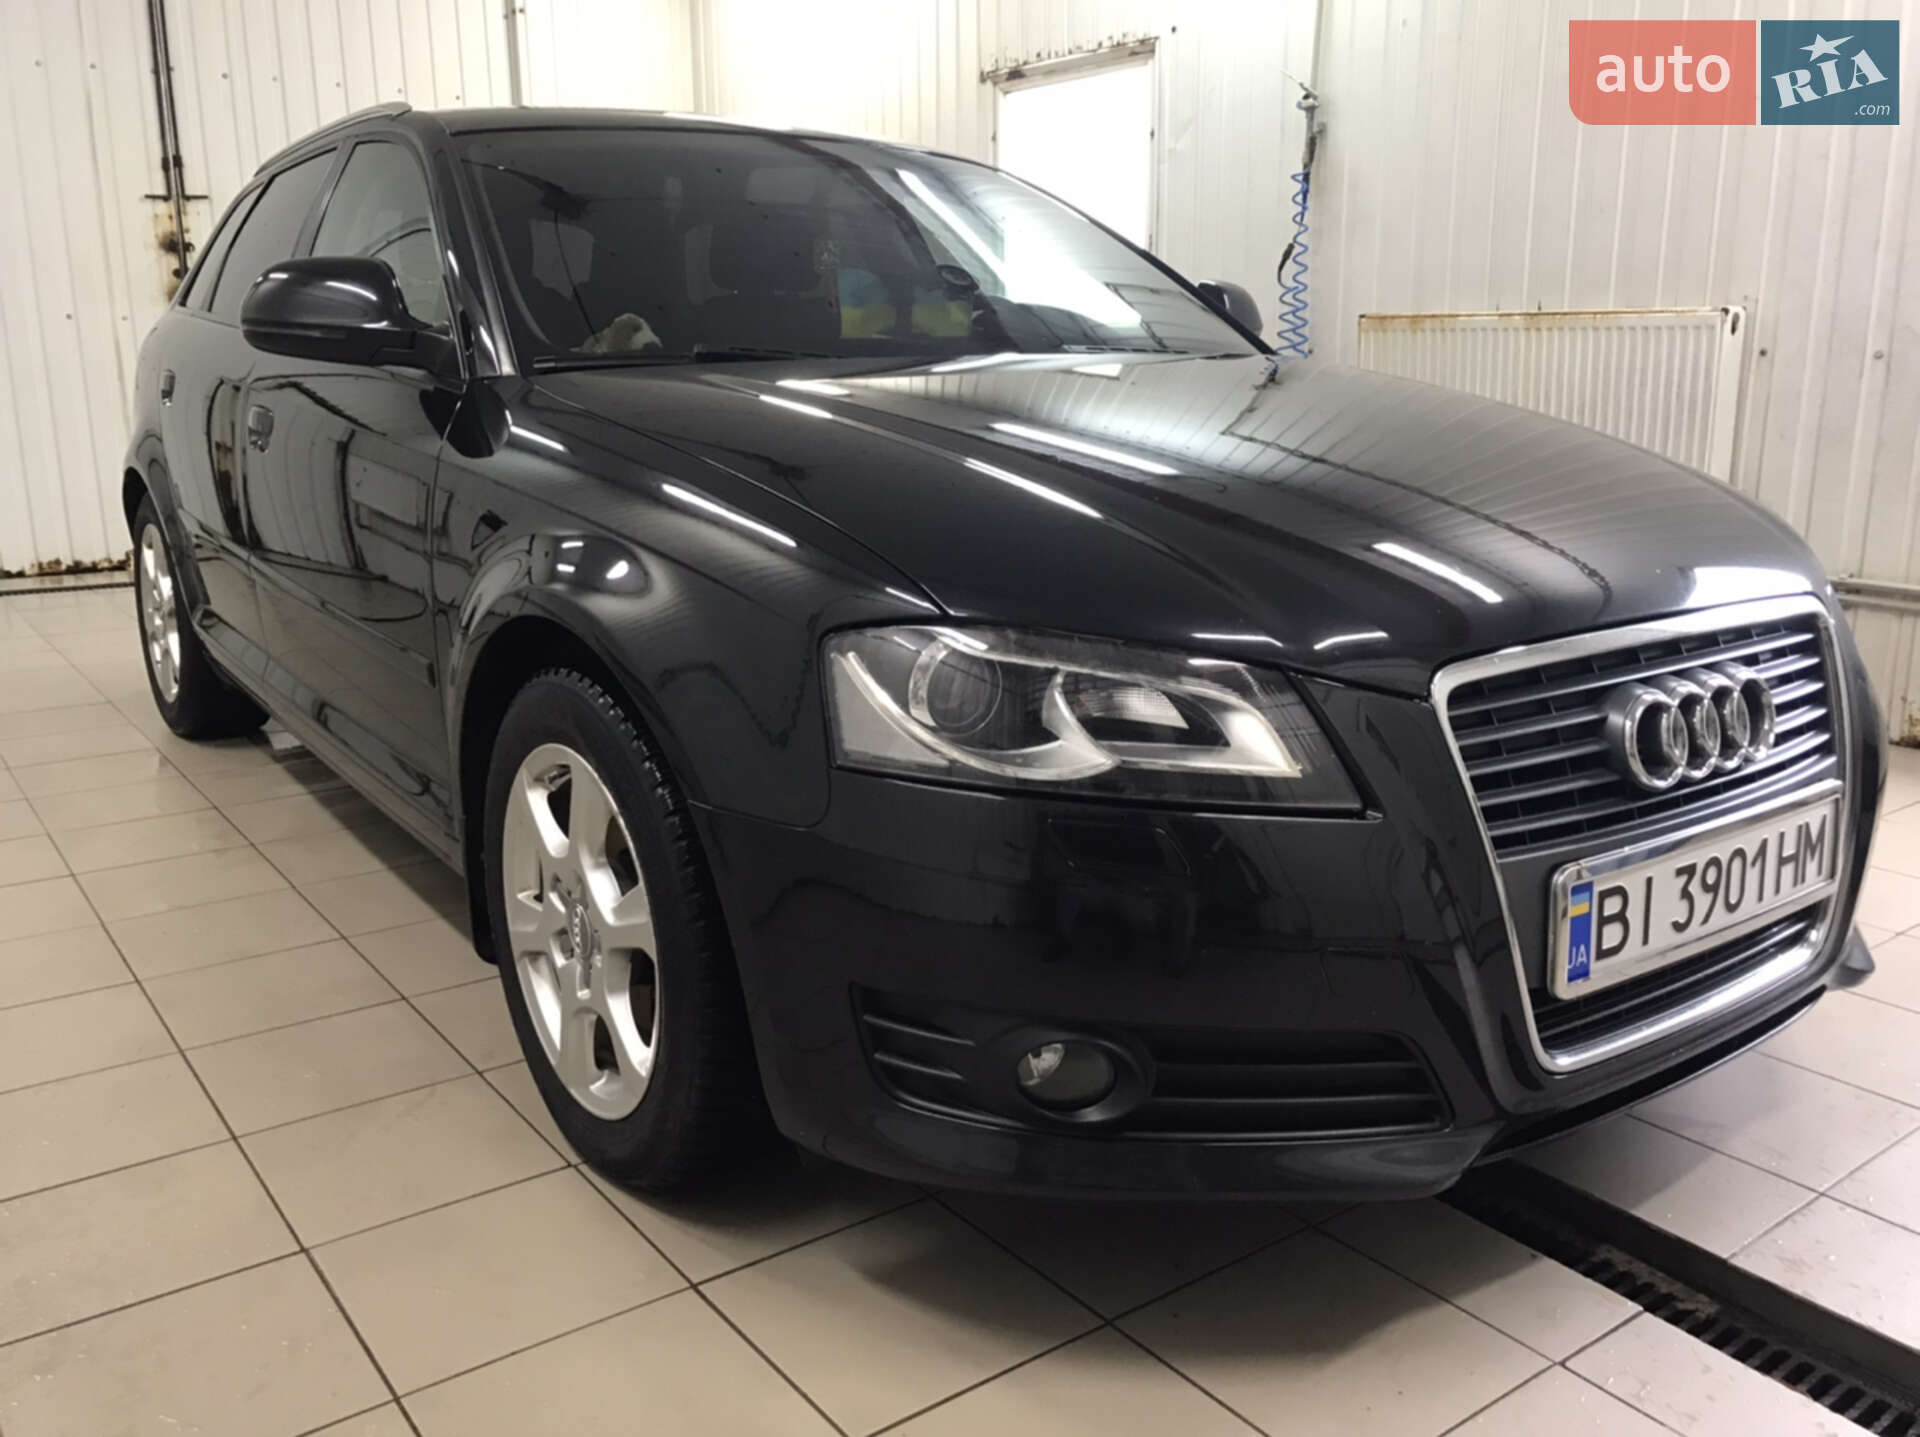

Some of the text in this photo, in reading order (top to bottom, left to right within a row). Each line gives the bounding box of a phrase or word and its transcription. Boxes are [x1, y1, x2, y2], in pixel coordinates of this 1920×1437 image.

[1595, 813, 1828, 961] BI 3901 HM
